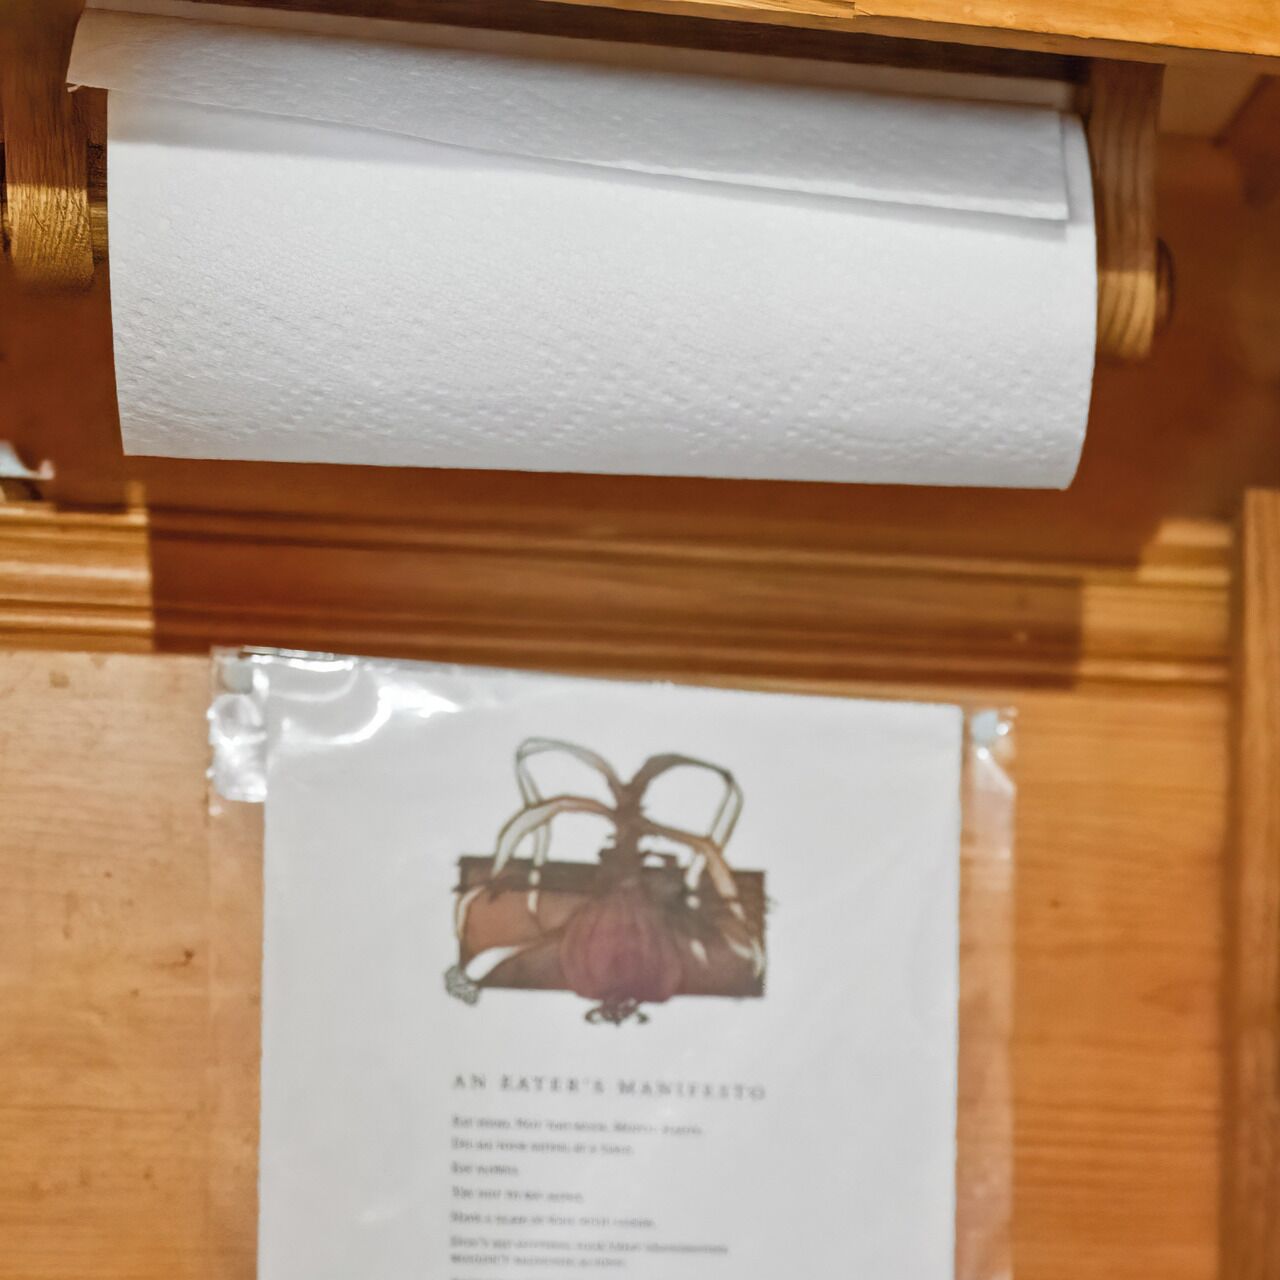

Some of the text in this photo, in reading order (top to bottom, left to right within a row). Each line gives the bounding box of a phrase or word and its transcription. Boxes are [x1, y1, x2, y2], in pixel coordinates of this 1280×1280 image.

[452, 1073, 768, 1101] AN EATER'S MANIFESTO
